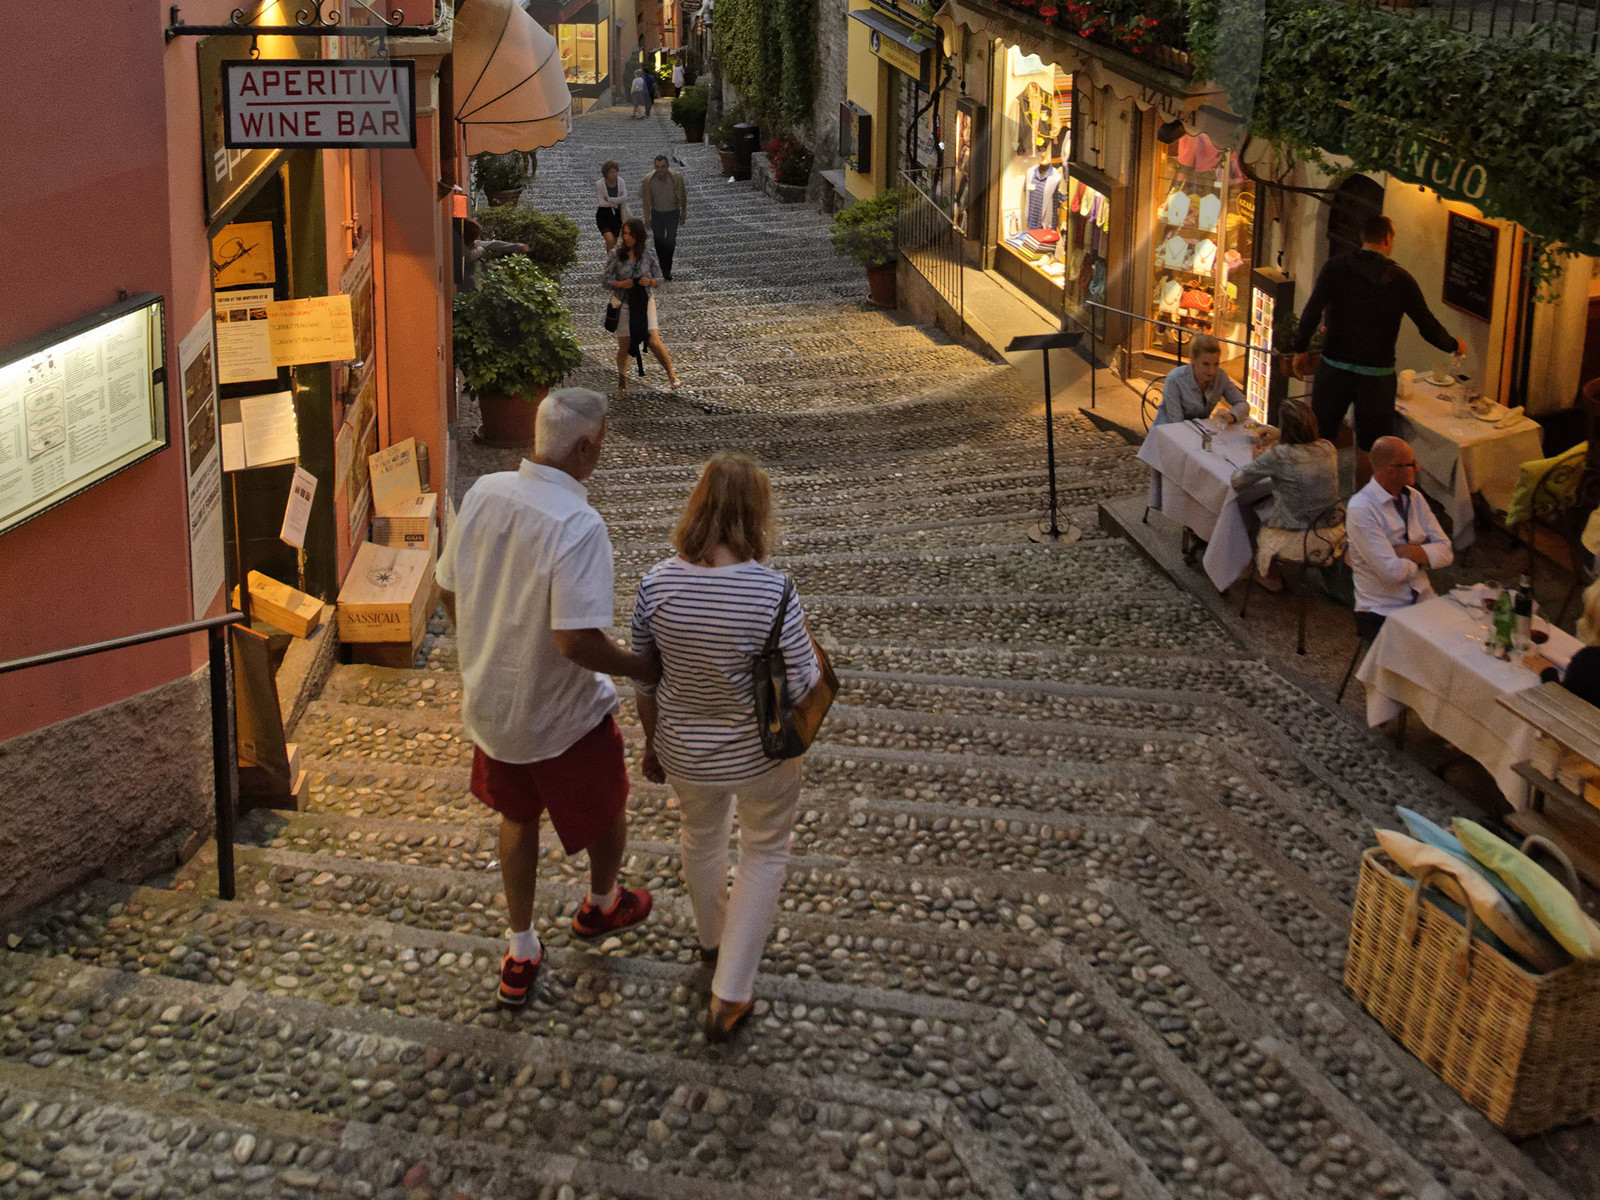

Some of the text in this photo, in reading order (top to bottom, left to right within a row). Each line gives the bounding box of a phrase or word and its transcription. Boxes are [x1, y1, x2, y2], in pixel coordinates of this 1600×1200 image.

[239, 70, 398, 97] APERITIVI
[239, 110, 401, 137] WINE BAR
[347, 612, 401, 624] SASSICAIA
